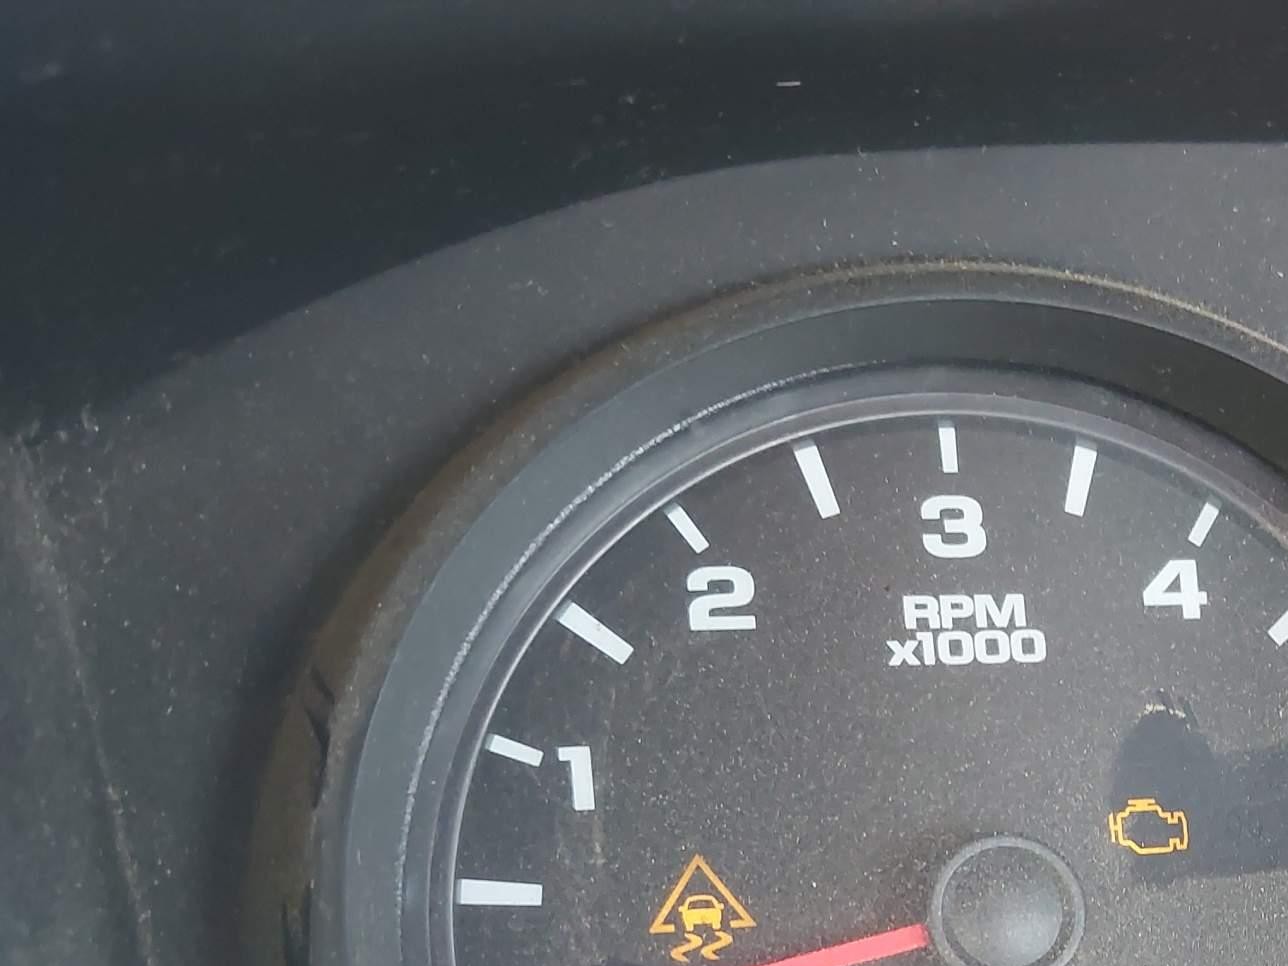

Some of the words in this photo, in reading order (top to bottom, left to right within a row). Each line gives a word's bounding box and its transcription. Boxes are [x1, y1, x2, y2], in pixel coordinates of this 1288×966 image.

[920, 495, 987, 558] 3
[686, 566, 756, 631] 2
[902, 593, 1028, 630] RPM
[1142, 559, 1208, 620] 4
[887, 630, 1046, 667] x1000
[558, 746, 595, 811] 1
